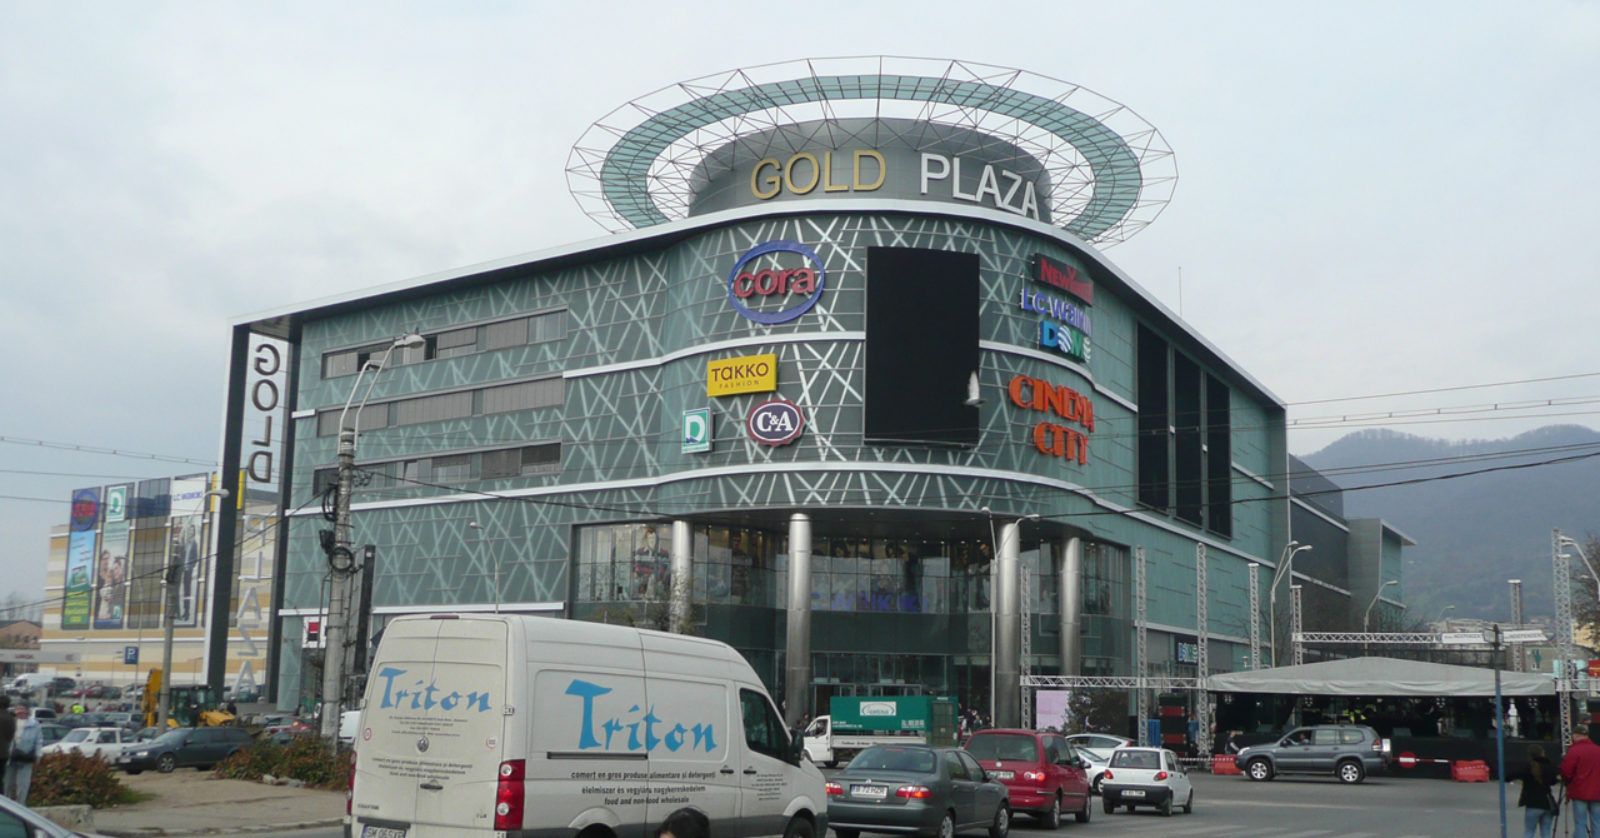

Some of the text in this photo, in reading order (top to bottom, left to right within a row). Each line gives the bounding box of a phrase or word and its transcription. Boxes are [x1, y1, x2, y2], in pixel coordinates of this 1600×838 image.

[751, 150, 1040, 221] GOLD PLAZA
[734, 267, 815, 298] cora
[719, 380, 760, 389] FASHION
[1009, 375, 1095, 432] CINEMA
[756, 411, 794, 433] C&A
[1033, 422, 1088, 465] CITY
[379, 667, 492, 712] Triton
[565, 679, 717, 752] Triton
